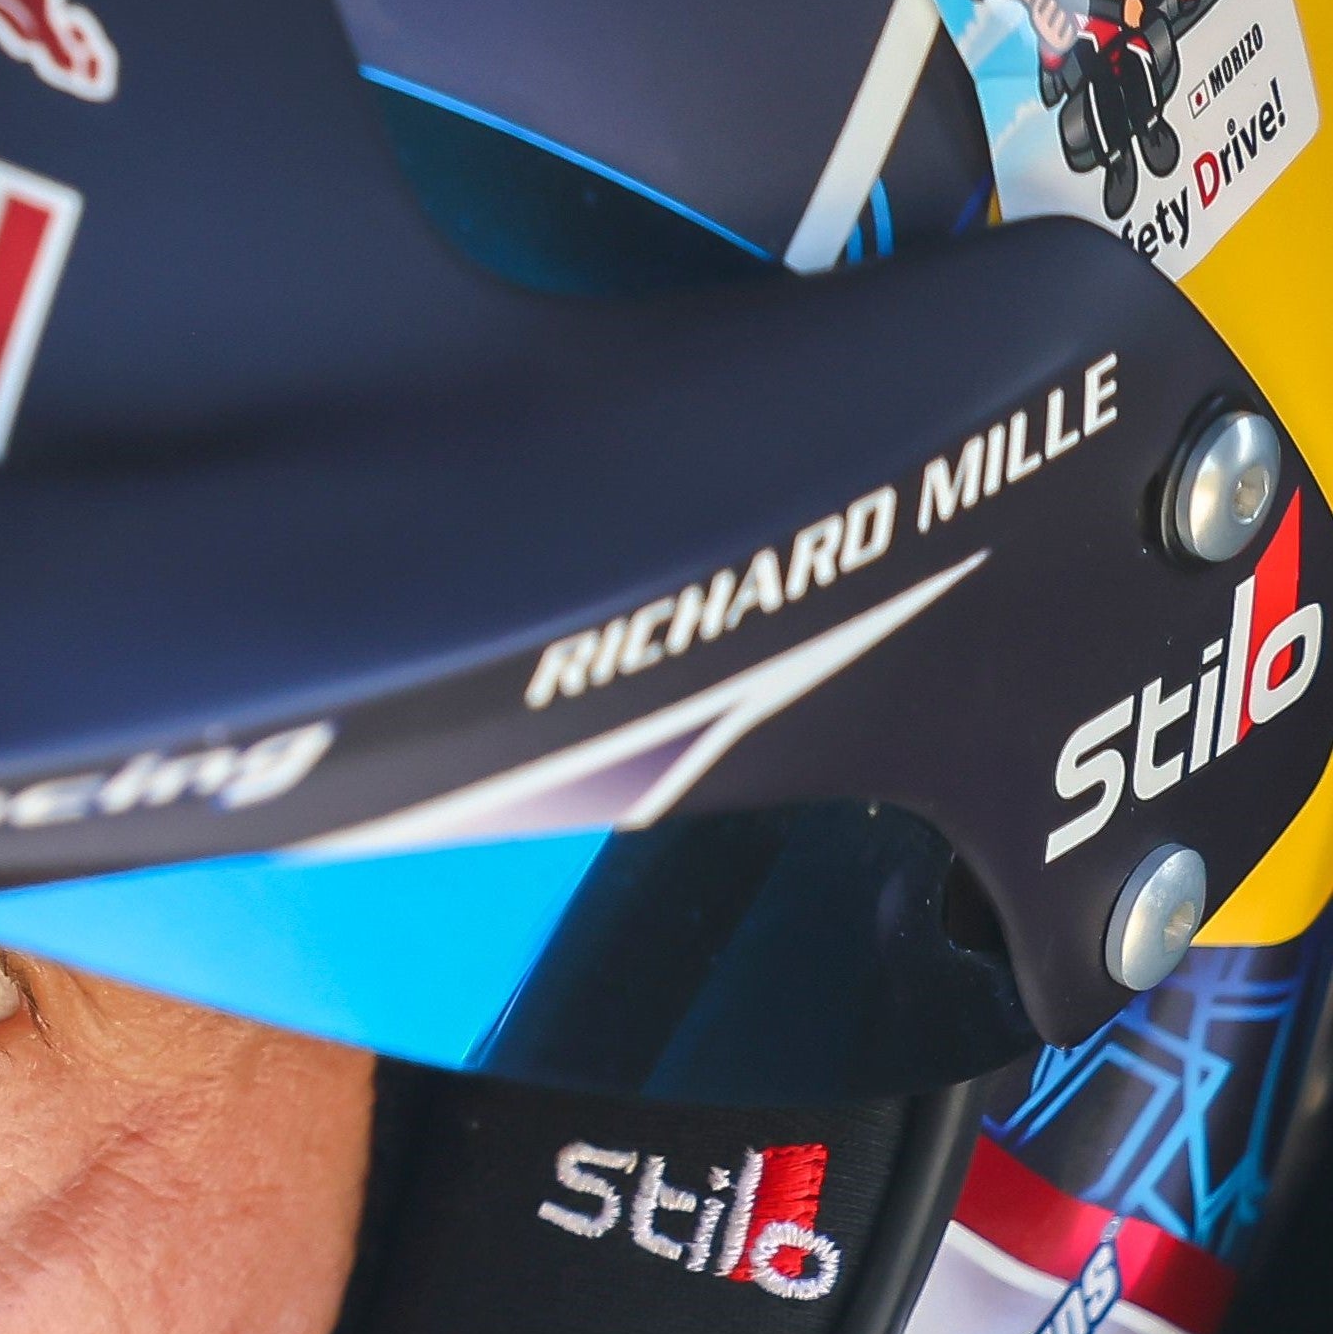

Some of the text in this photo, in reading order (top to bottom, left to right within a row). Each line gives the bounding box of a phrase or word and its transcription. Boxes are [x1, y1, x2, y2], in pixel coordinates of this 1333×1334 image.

[1207, 22, 1264, 98] MORIZO
[1121, 76, 1287, 259] ety Drive!
[525, 352, 1119, 709] RICHARD MILLE
[1044, 572, 1325, 866] Stilo
[538, 1140, 842, 1301] Stilo
